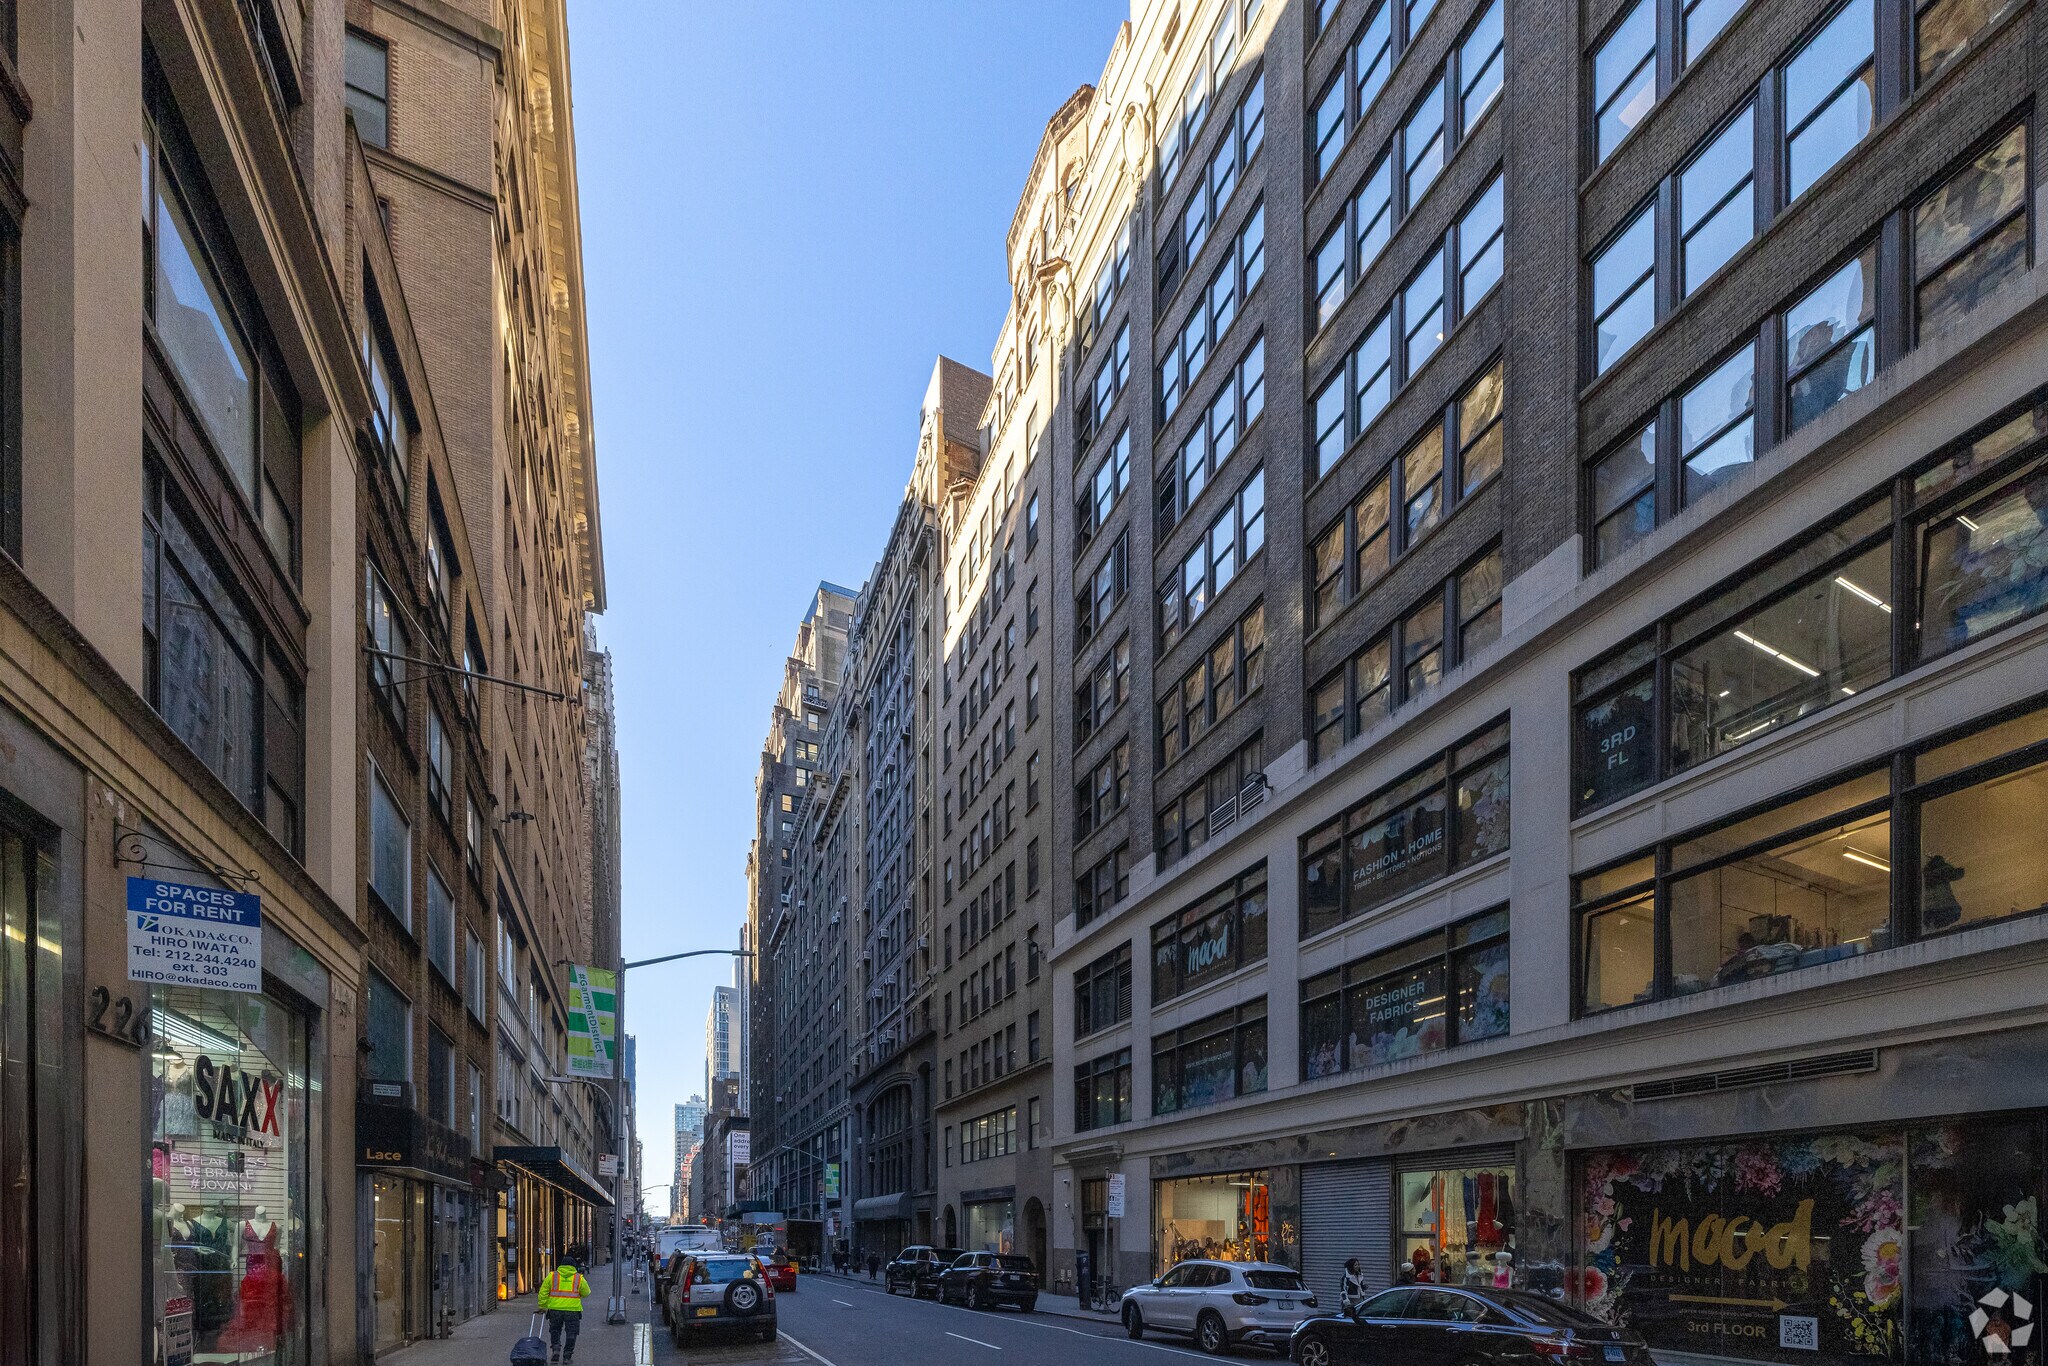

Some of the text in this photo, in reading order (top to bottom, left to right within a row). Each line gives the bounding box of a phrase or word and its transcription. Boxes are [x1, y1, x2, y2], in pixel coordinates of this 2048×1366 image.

[1600, 725, 1636, 753] 3RD
[1607, 751, 1629, 770] FL
[1353, 827, 1443, 881] FASHION HOME
[1353, 842, 1442, 891] TRIMS BUTTONS NOTIONS
[155, 884, 235, 907] SPACES
[145, 897, 244, 922] FOR RENT
[151, 935, 239, 955] HIRO IWATA
[162, 925, 253, 945] OKADA&CO.
[133, 945, 256, 969] Tel: 212.244.4240
[1187, 924, 1228, 976] mood
[131, 969, 257, 991] HIRO@okadaco.com
[172, 963, 228, 977] ext. 303
[1366, 981, 1425, 1010] DESIGNER
[578, 973, 604, 1053] #GarmentDistrict
[1370, 1000, 1420, 1025] FABRICS
[193, 1055, 283, 1137] SAXX
[246, 1137, 265, 1149] ITALY
[366, 1147, 402, 1161] Lace
[170, 1152, 267, 1167] BE FEARSS
[183, 1165, 201, 1177] BE
[1649, 1198, 1815, 1273] mood
[1650, 1274, 1810, 1289] DESIGNER FABRICS
[1687, 1320, 1766, 1338] 3rd FLOOR
